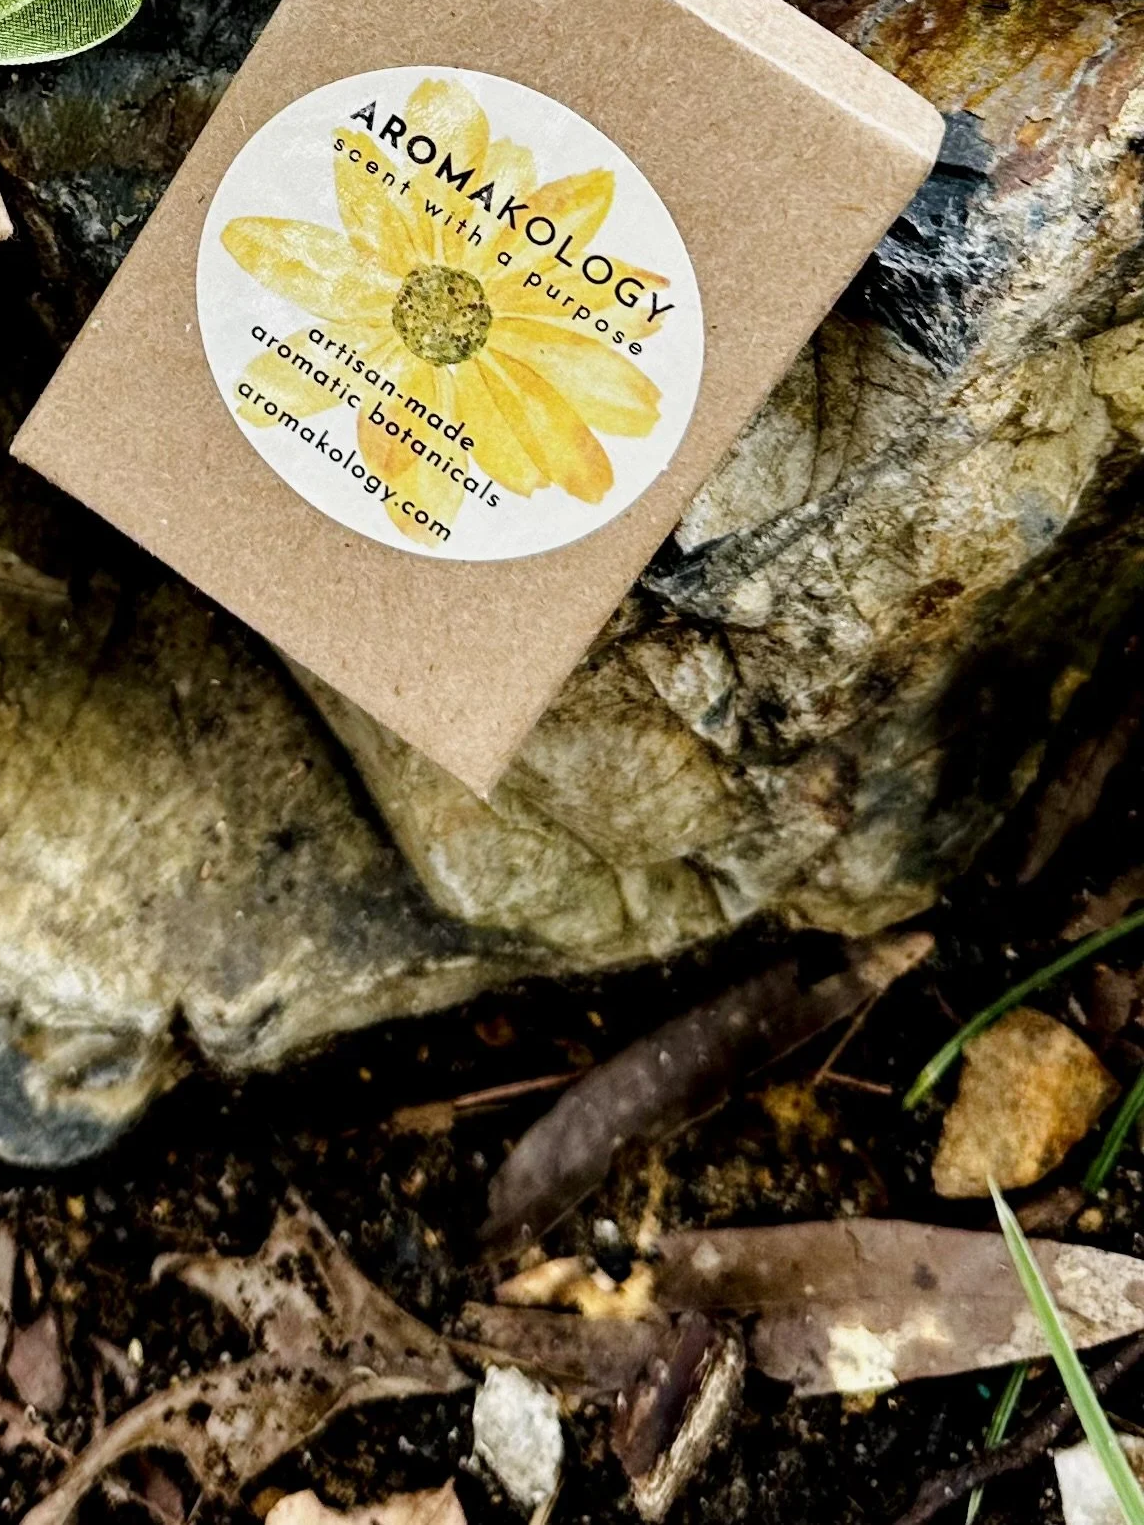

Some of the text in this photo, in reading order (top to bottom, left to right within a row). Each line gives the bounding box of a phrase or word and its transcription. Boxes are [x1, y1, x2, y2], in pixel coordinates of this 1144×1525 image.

[333, 136, 643, 357] scent with a purpose
[350, 99, 676, 324] AROMAKOLOGY
[237, 380, 452, 542] aromakology.com
[251, 324, 501, 509] aromatic botanicals
[308, 327, 475, 452] artisan-made
